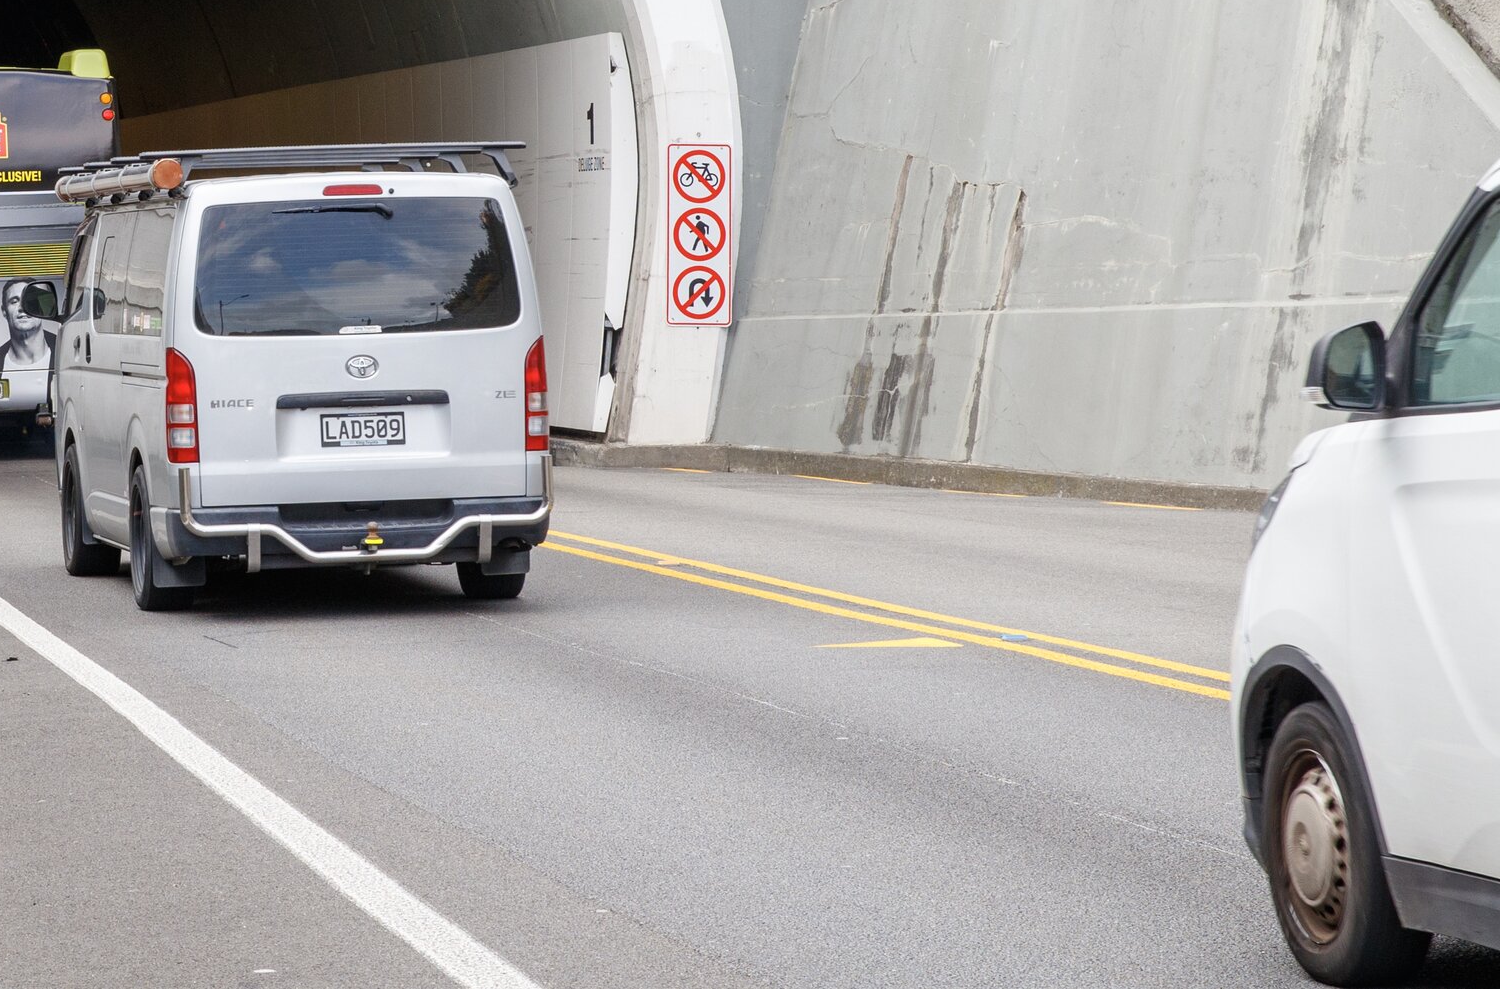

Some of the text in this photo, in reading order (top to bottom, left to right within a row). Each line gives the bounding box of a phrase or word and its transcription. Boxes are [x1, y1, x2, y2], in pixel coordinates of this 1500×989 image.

[586, 102, 595, 145] 1
[210, 399, 255, 409] HIACE
[325, 419, 401, 440] LAD509
